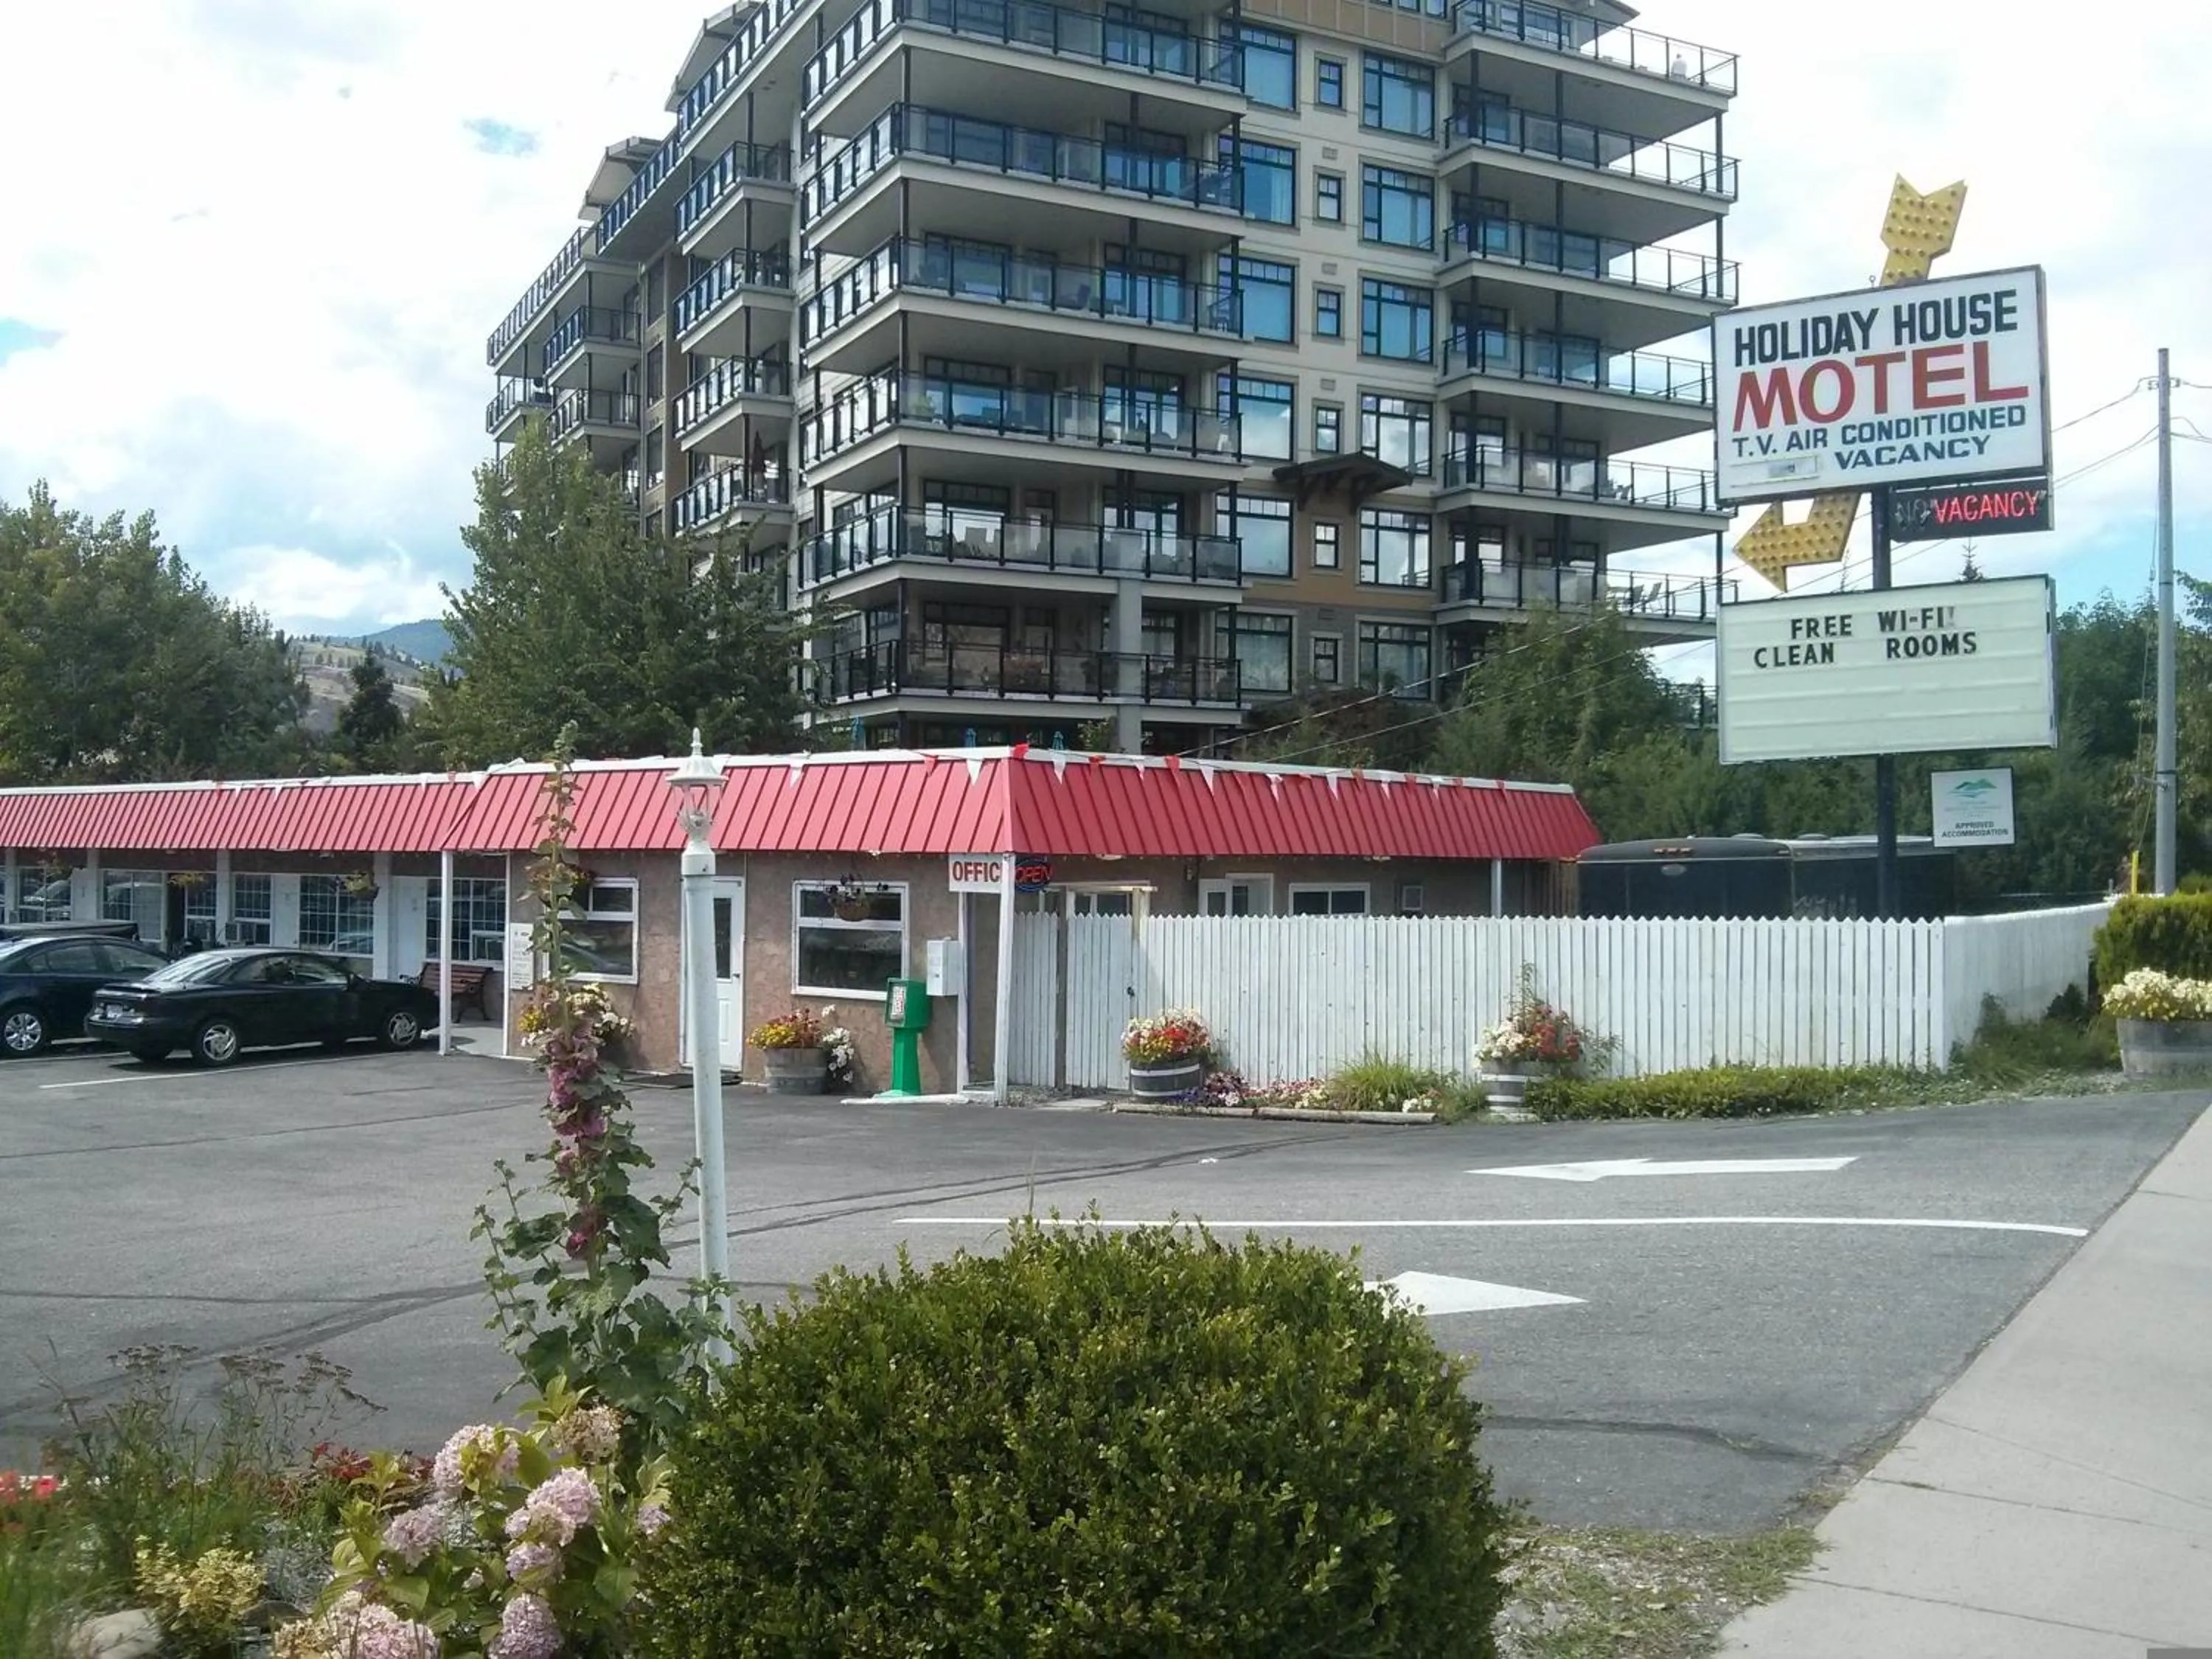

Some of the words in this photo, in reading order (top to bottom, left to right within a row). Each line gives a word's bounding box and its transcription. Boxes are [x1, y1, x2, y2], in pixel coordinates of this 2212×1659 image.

[1734, 307, 1879, 367] HOLIDAY
[1893, 289, 2017, 346] HOUSE
[1733, 341, 2029, 433] MOTEL
[1732, 434, 1778, 458] T.V.
[1786, 428, 1829, 452] AIR
[1841, 405, 2026, 445] CONDITIONED
[1834, 435, 1991, 470] VACANCY
[1933, 490, 2039, 524] VACANCY
[1790, 614, 1853, 640] FREE
[1753, 642, 1834, 669] CLEAN
[1886, 632, 1977, 661] ROOMS
[1941, 829, 2009, 838] ACCOMMODATION
[953, 860, 1001, 883] OFFIC
